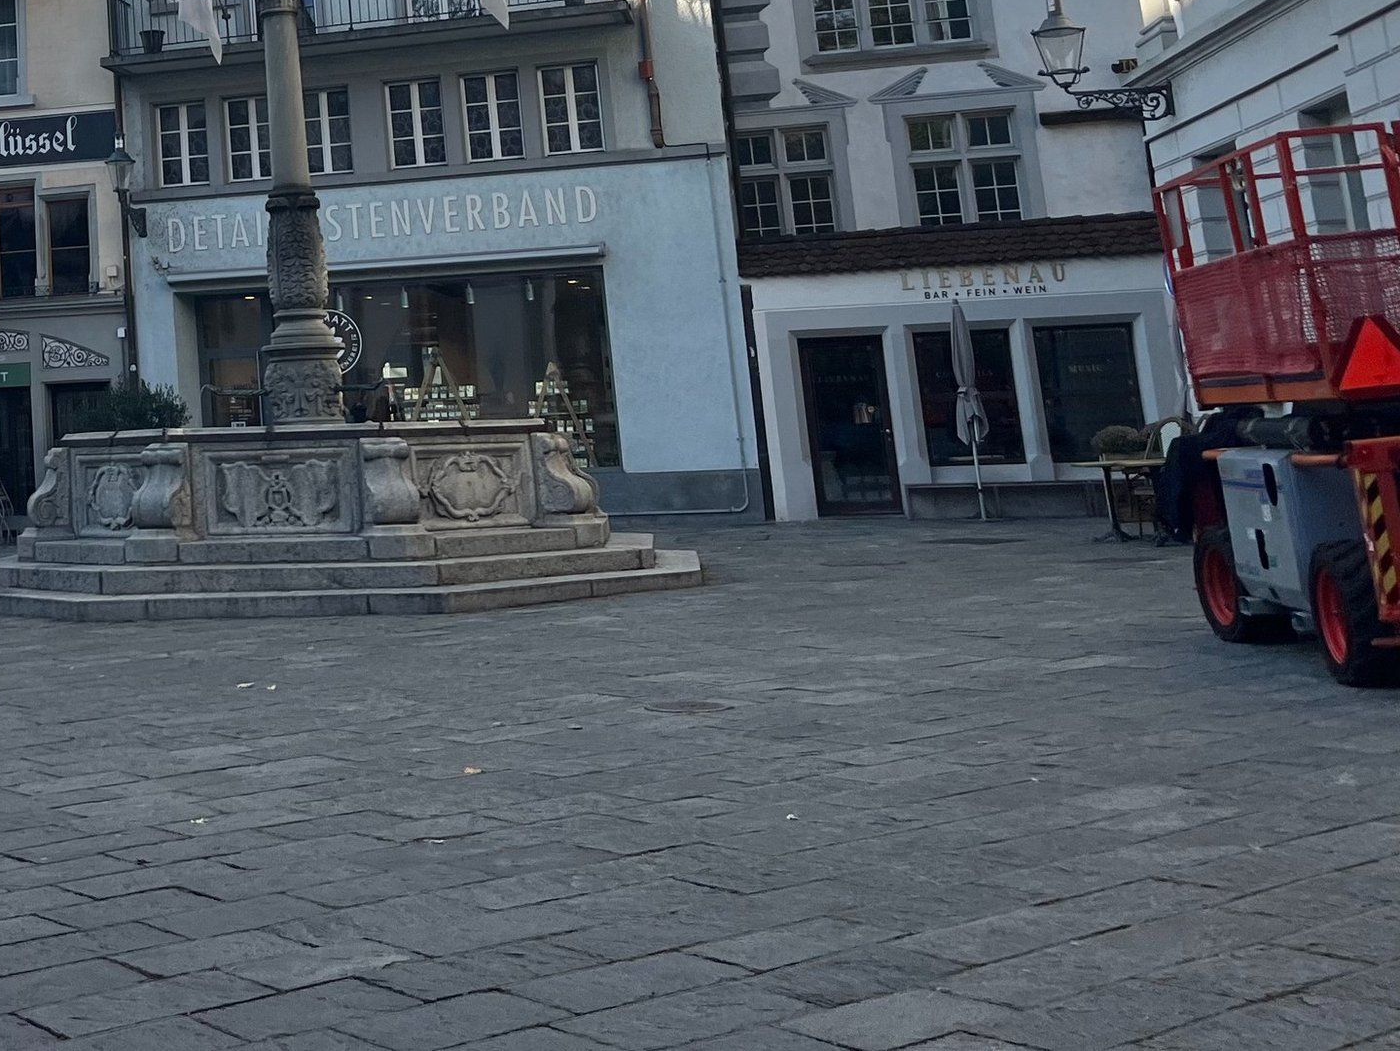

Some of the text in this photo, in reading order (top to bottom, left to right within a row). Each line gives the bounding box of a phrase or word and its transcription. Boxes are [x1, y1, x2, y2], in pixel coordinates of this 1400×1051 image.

[167, 185, 598, 253] DETAISTENVERBAND
[901, 261, 1066, 291] LIEBENAU
[924, 285, 1047, 300] BAR FEIN WEIN
